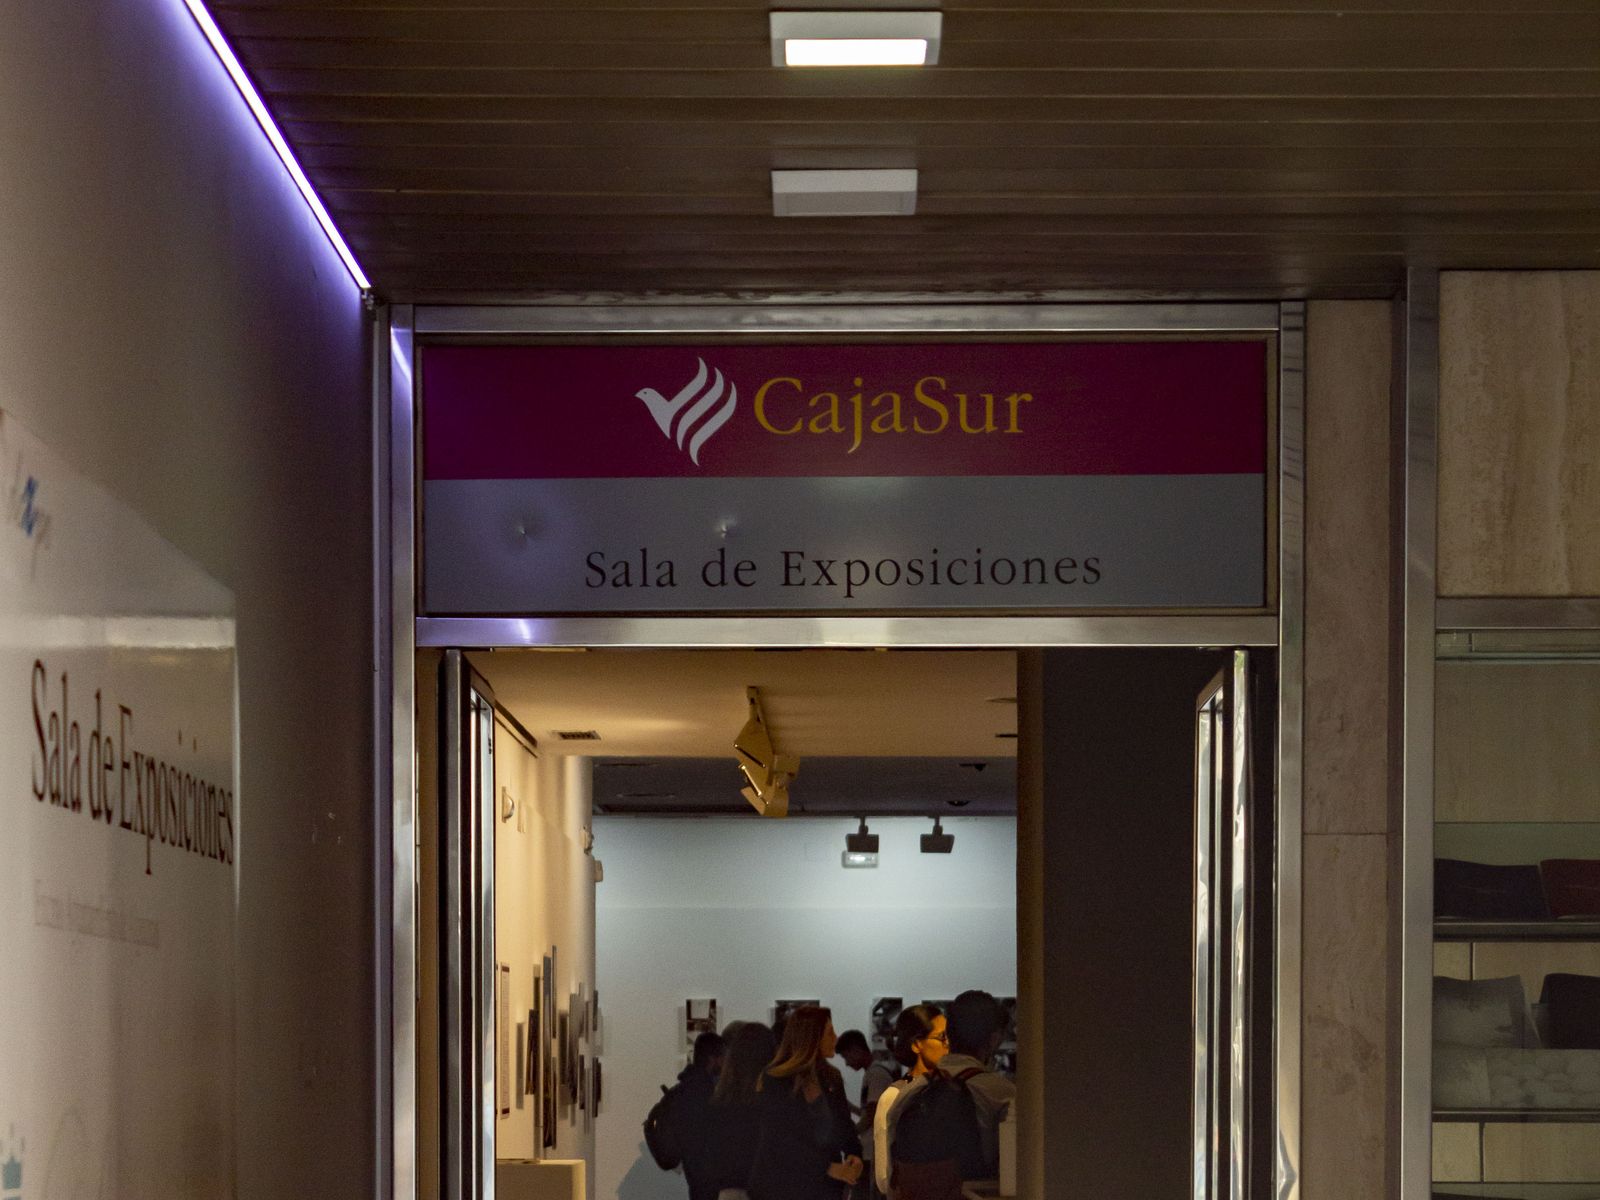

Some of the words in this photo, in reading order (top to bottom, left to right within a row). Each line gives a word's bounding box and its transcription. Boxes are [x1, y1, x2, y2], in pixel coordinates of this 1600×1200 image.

[753, 375, 1034, 454] CajaSur
[585, 547, 678, 589] Sala
[701, 547, 758, 588] de
[780, 548, 1101, 599] Exposiciones
[32, 658, 81, 813] Sala
[89, 687, 114, 825] de
[119, 703, 234, 875] Exposiciones
